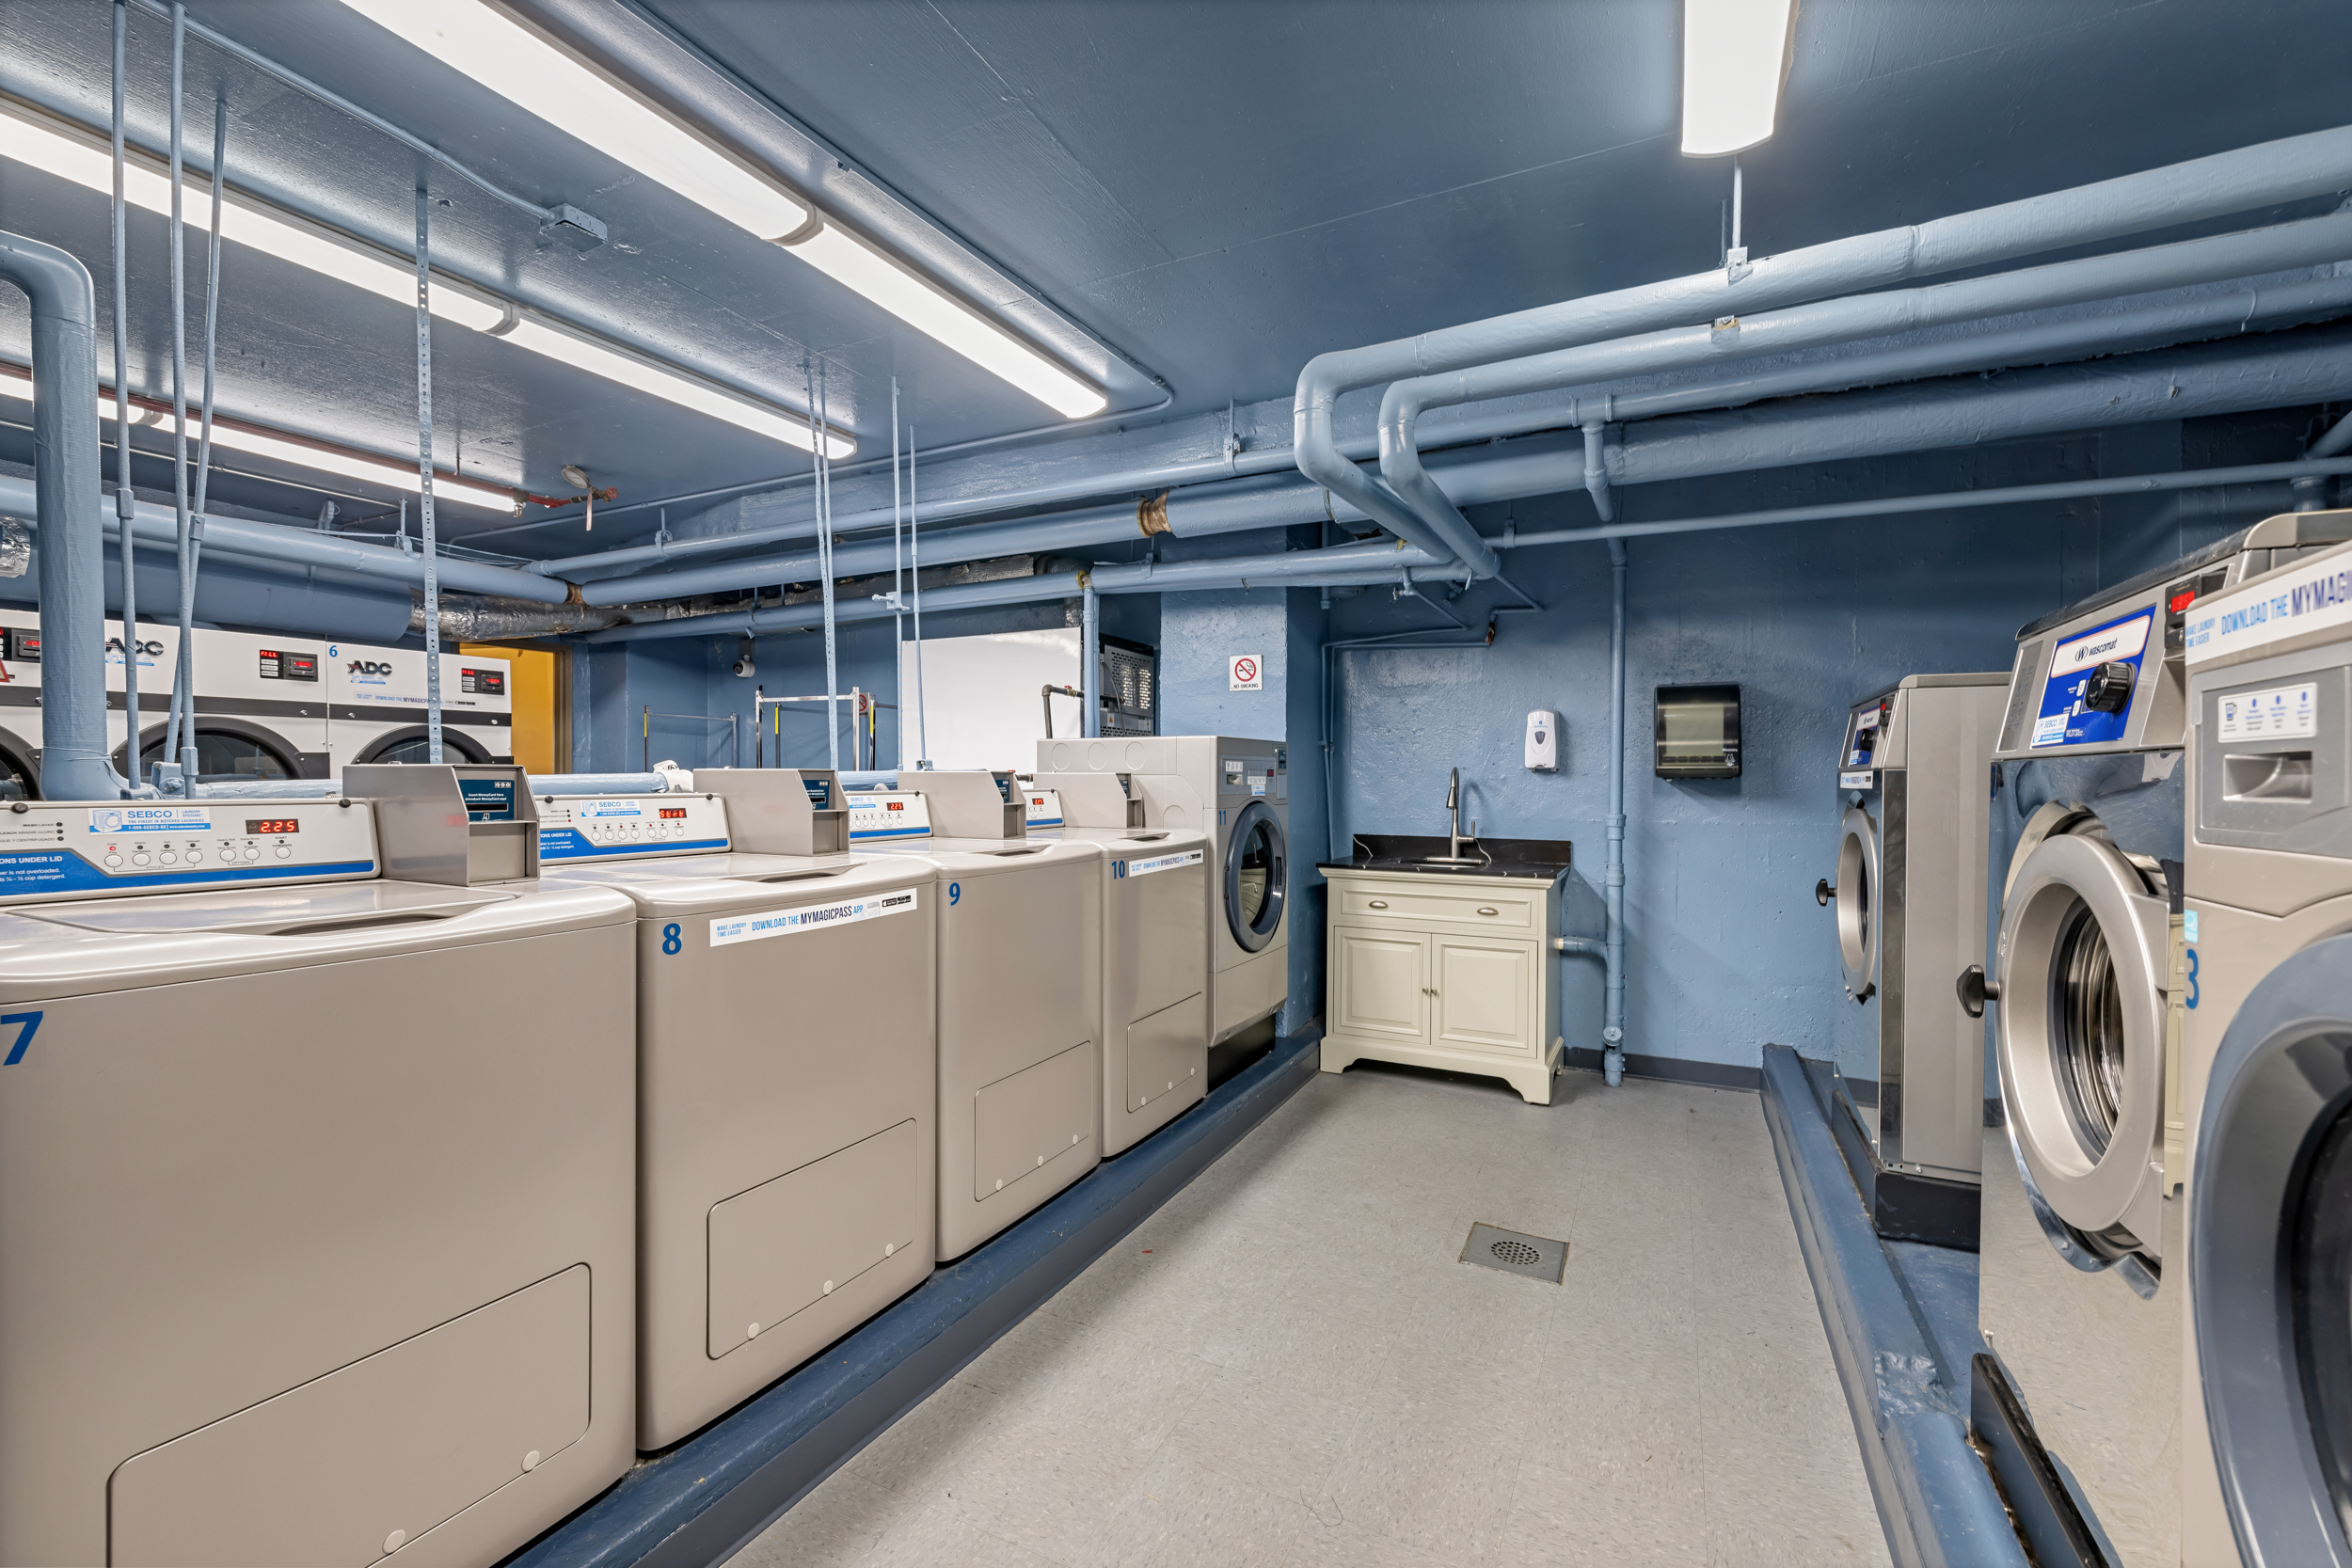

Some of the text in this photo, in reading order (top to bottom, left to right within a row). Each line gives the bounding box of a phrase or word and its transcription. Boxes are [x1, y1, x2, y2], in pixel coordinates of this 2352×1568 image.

[2221, 602, 2267, 635] DOWNLOAD
[2270, 594, 2288, 620] THE
[2198, 617, 2216, 633] LAUNDRY
[2089, 638, 2117, 657] wascomat
[2185, 632, 2210, 649] TIME EASIER
[329, 645, 338, 657] 6
[346, 660, 392, 676] ADC
[127, 810, 173, 818] SEBCO
[1218, 810, 1226, 826] 11
[260, 820, 295, 832] 2.25
[1111, 860, 1125, 879] 10
[949, 882, 961, 906] 9
[752, 905, 864, 931] DOWNLOAD THE MYMAGICPASS APP
[662, 923, 682, 956] 8
[2185, 948, 2200, 1010] 3
[0, 1010, 43, 1066] 7
